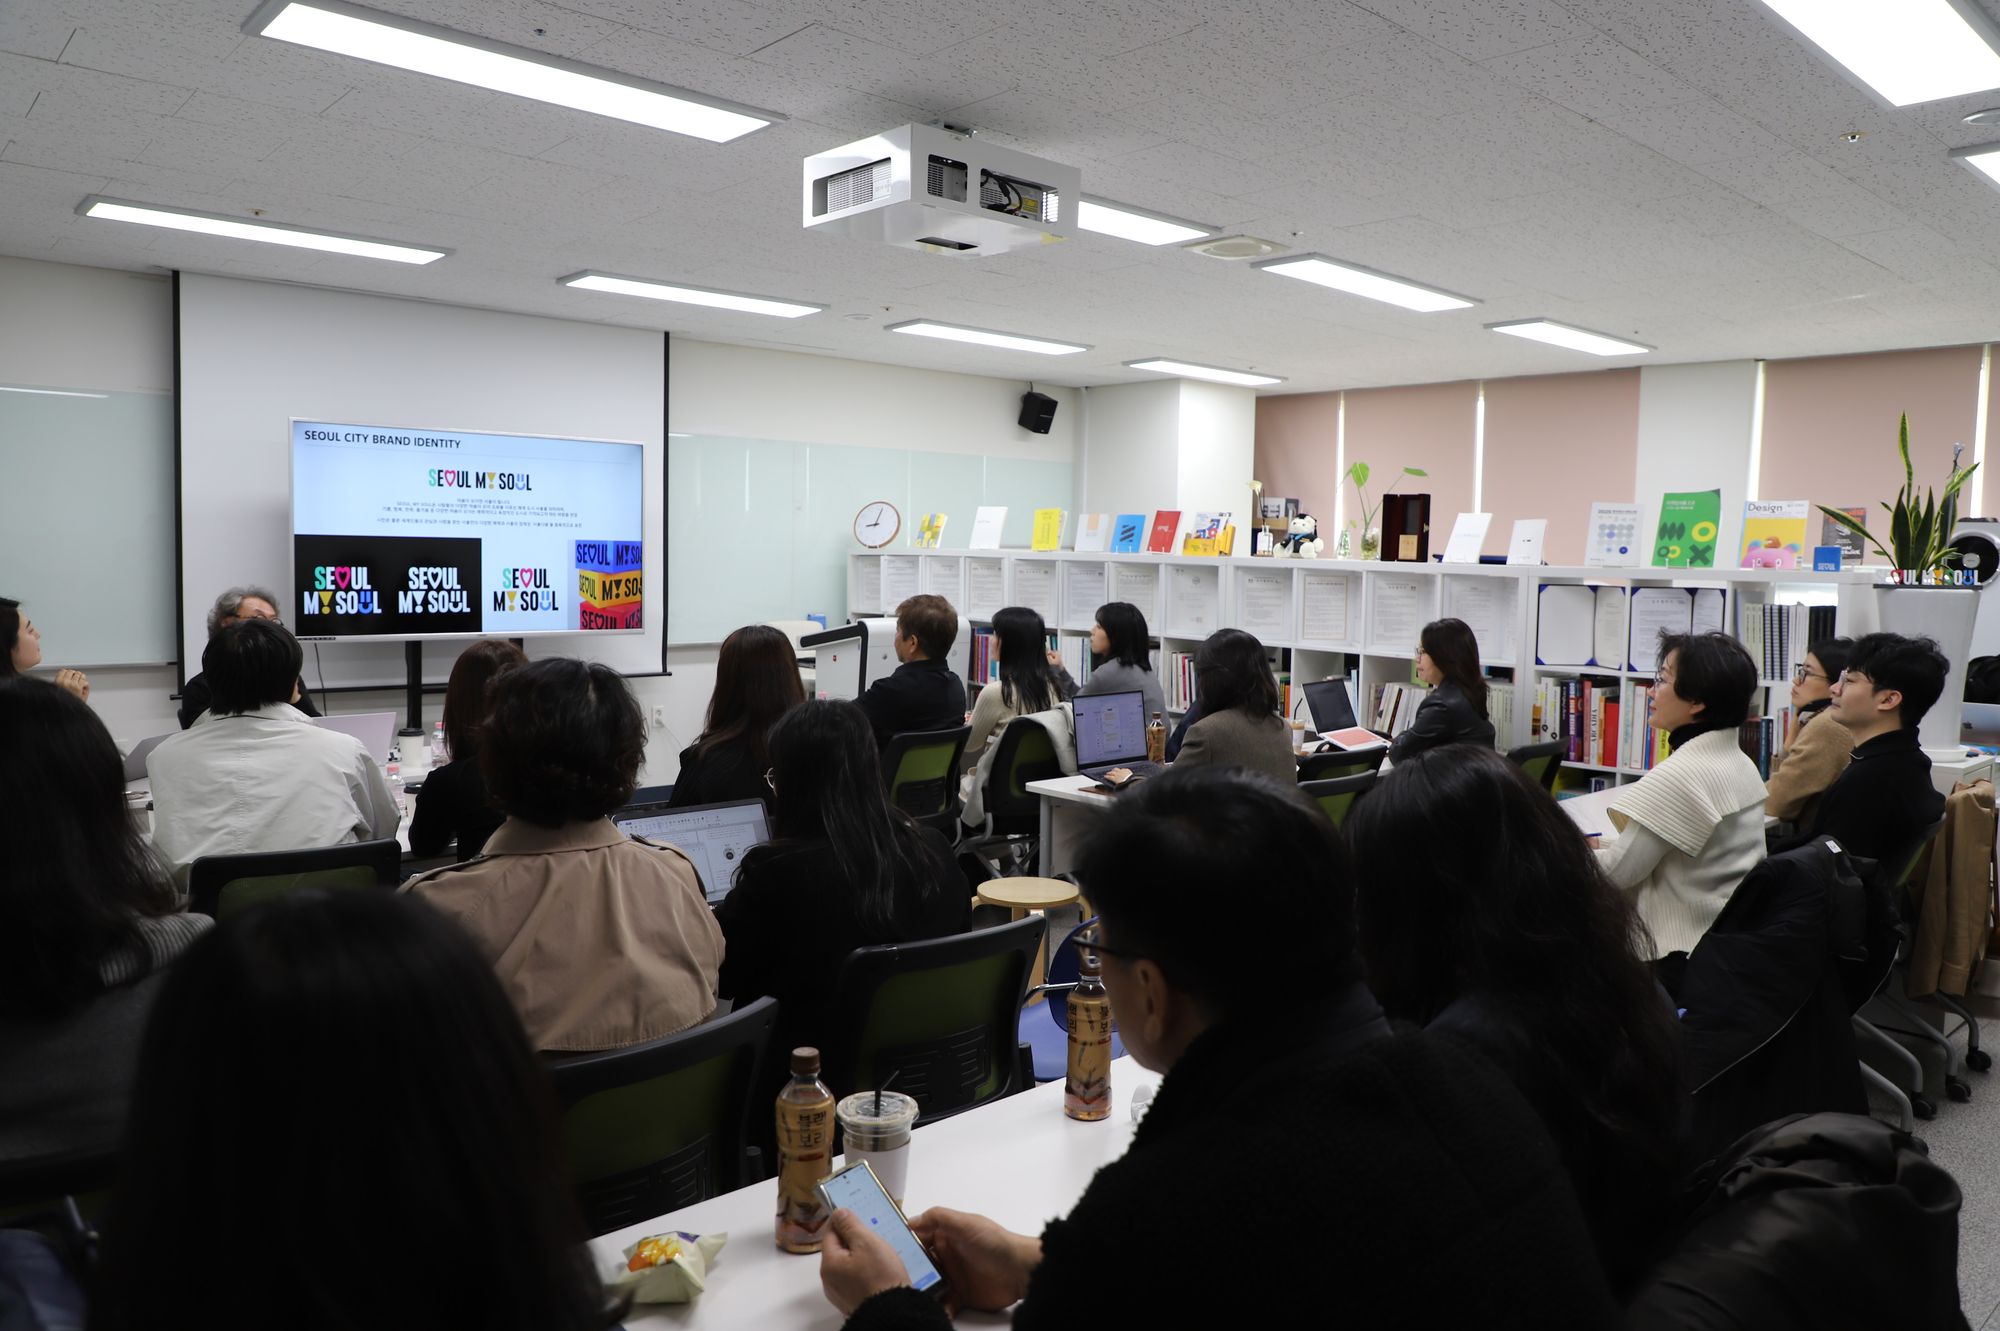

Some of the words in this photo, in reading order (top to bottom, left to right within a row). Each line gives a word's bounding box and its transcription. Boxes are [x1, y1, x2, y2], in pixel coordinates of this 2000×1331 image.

[304, 430, 341, 442] SEOUL
[344, 432, 369, 443] CITY
[373, 434, 411, 446] BRAND
[414, 437, 461, 449] IDENTITY
[499, 472, 532, 491] SOUL
[1748, 502, 1783, 513] Design
[335, 591, 382, 615] SOUL
[428, 591, 471, 614] SOUL
[520, 590, 559, 612] SOUL
